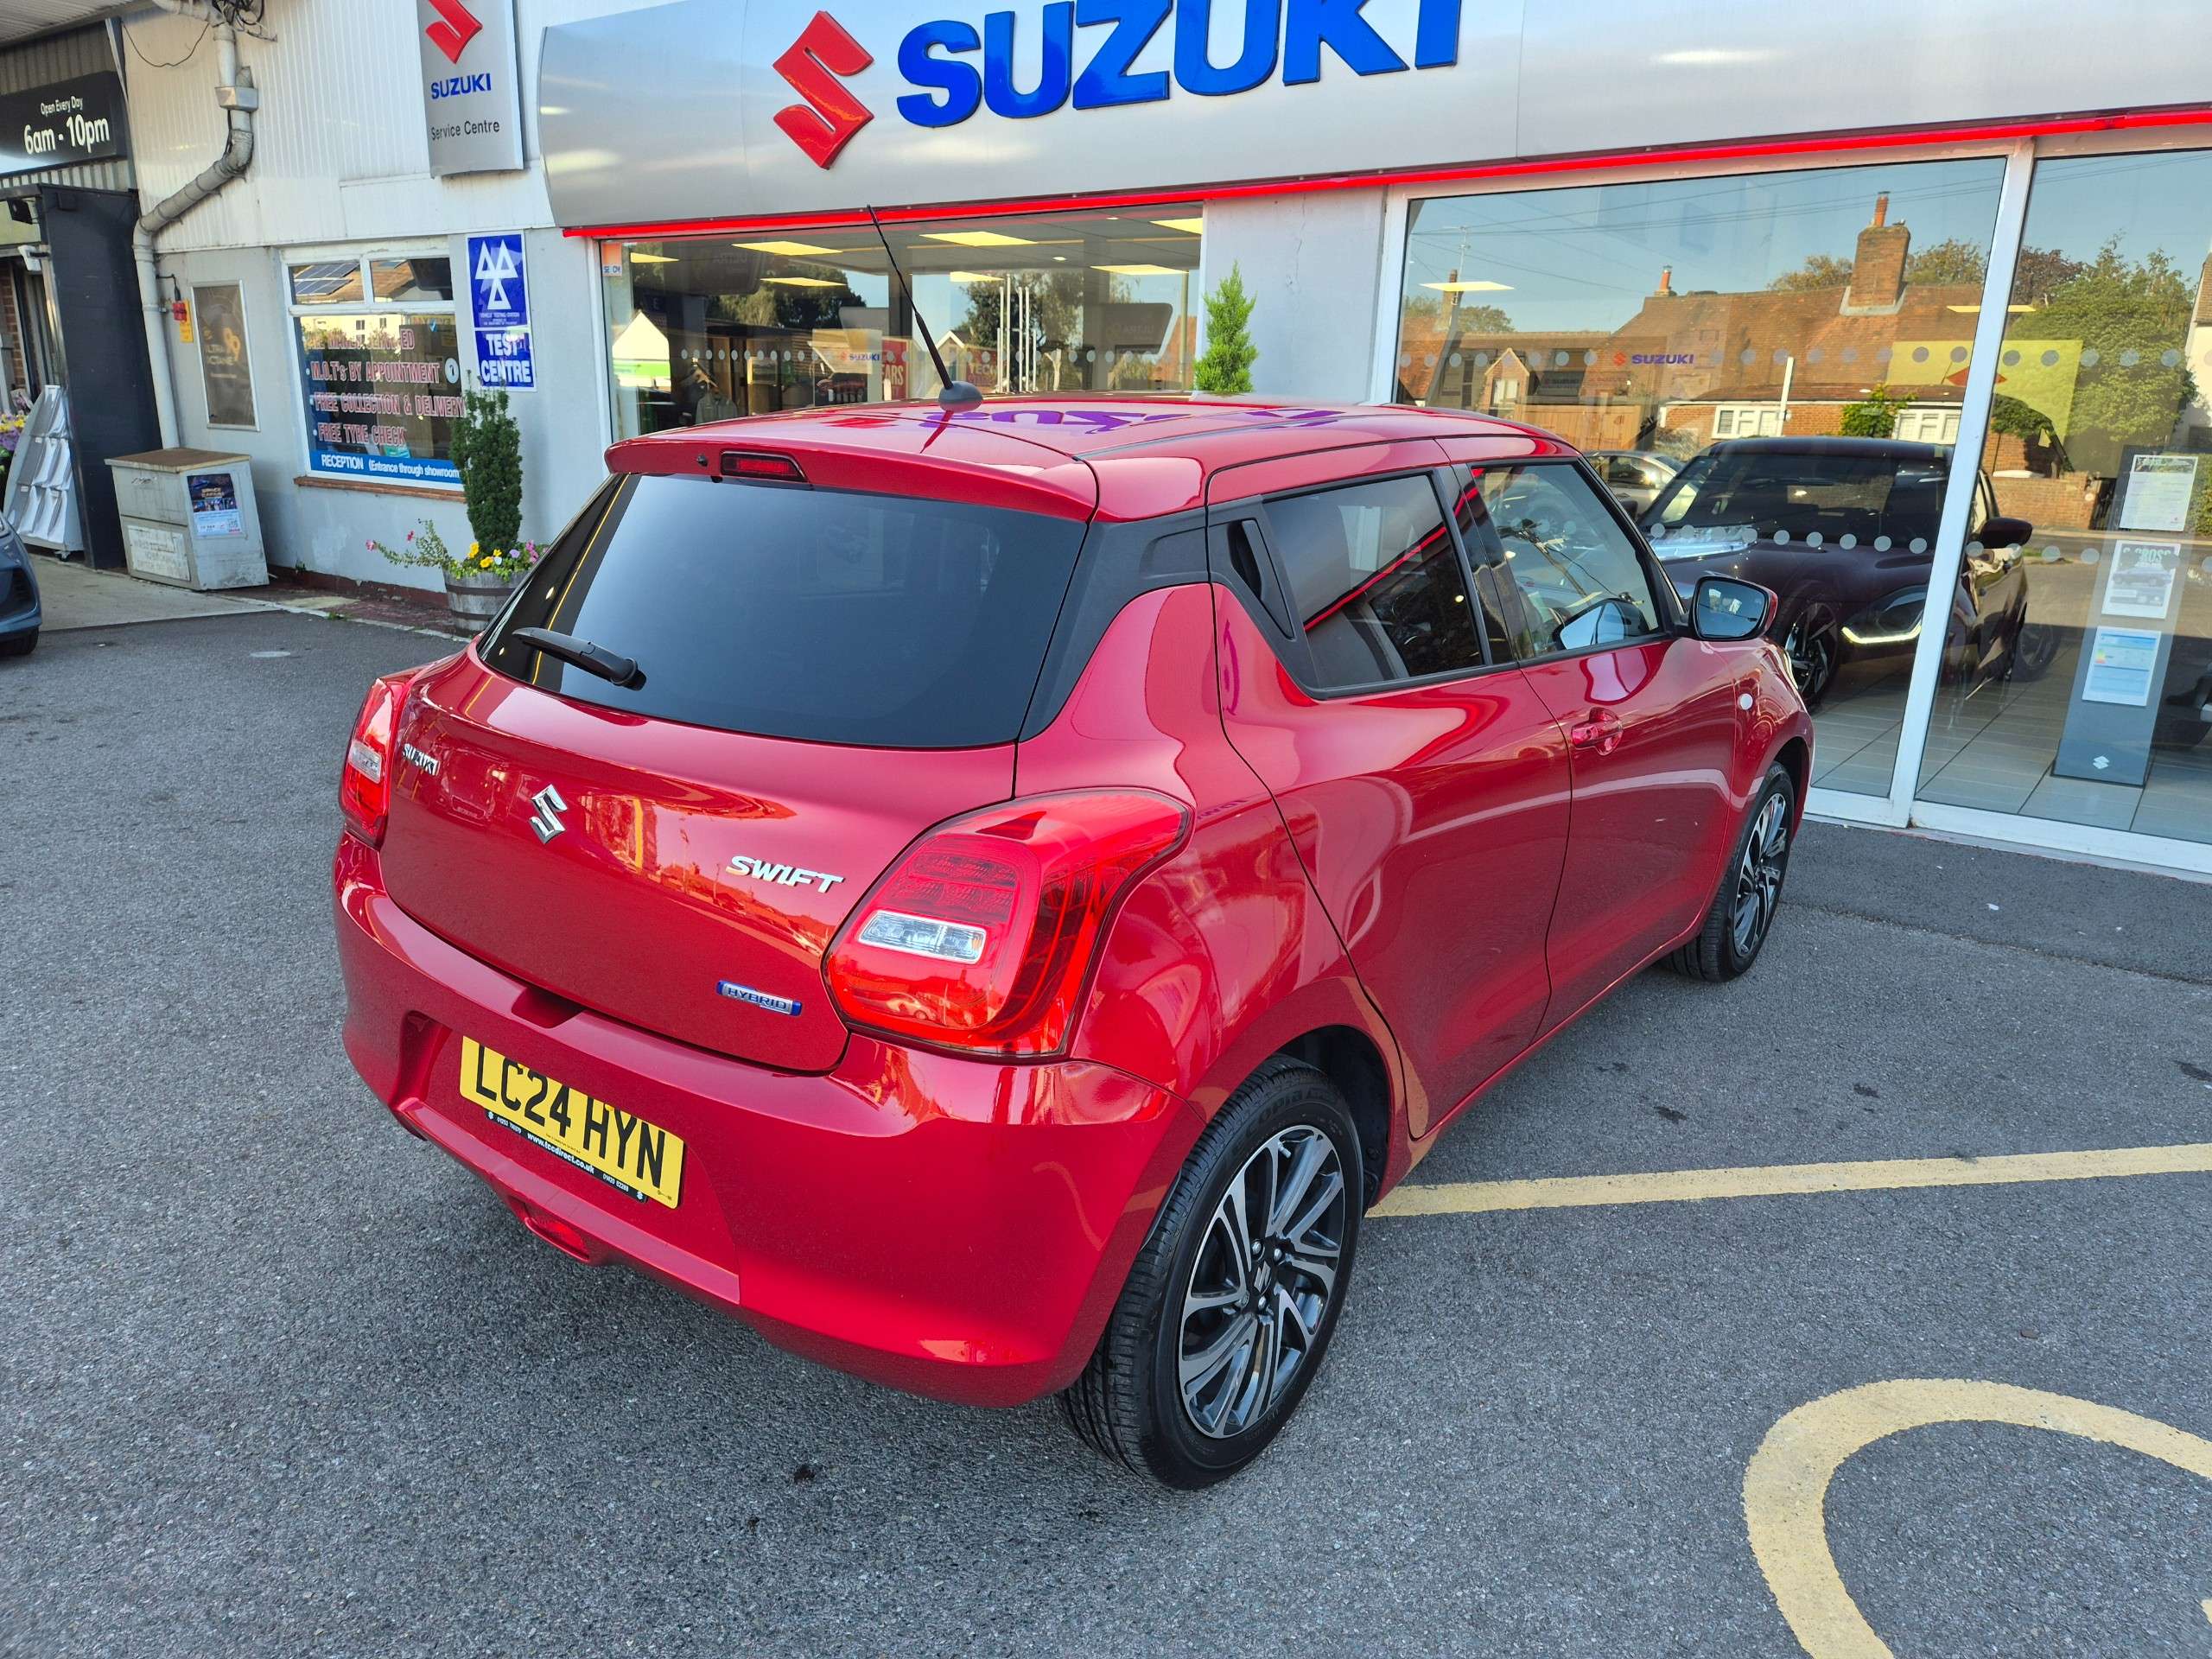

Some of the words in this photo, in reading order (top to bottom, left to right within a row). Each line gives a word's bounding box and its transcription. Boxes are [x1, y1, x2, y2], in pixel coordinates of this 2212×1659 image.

[897, 0, 1461, 128] SUZUKI
[430, 73, 492, 99] SUZUKI
[40, 102, 55, 117] Open
[55, 99, 70, 112] Every
[71, 95, 84, 111] Day
[23, 124, 56, 155] 6am
[66, 114, 110, 153] 10pm
[431, 124, 461, 141] Service
[464, 120, 500, 135] Centre
[486, 334, 518, 357] TEST
[849, 352, 880, 362] SUZUKI
[481, 359, 532, 383] CENTRE
[1631, 353, 1694, 365] SUZUKI
[348, 361, 363, 382] BY
[365, 361, 441, 384] APPOINTMENT
[315, 391, 339, 412] FREE
[340, 392, 400, 415] COLLECTION
[404, 393, 412, 416] &
[415, 395, 467, 418] DELIVERY
[317, 422, 342, 443] FREE
[344, 424, 369, 444] TYRE
[372, 425, 408, 448] CHECK
[321, 454, 365, 470] RECEPTION
[368, 458, 398, 474] (Entrance
[399, 463, 424, 477] through
[403, 743, 440, 776] SUZUKI
[725, 855, 845, 893] SWIFT
[728, 986, 787, 1010] HYBRID
[475, 1043, 571, 1138] LC24
[582, 1095, 666, 1190] HYN
[526, 1130, 595, 1175] www.tccdirect.co.uk
